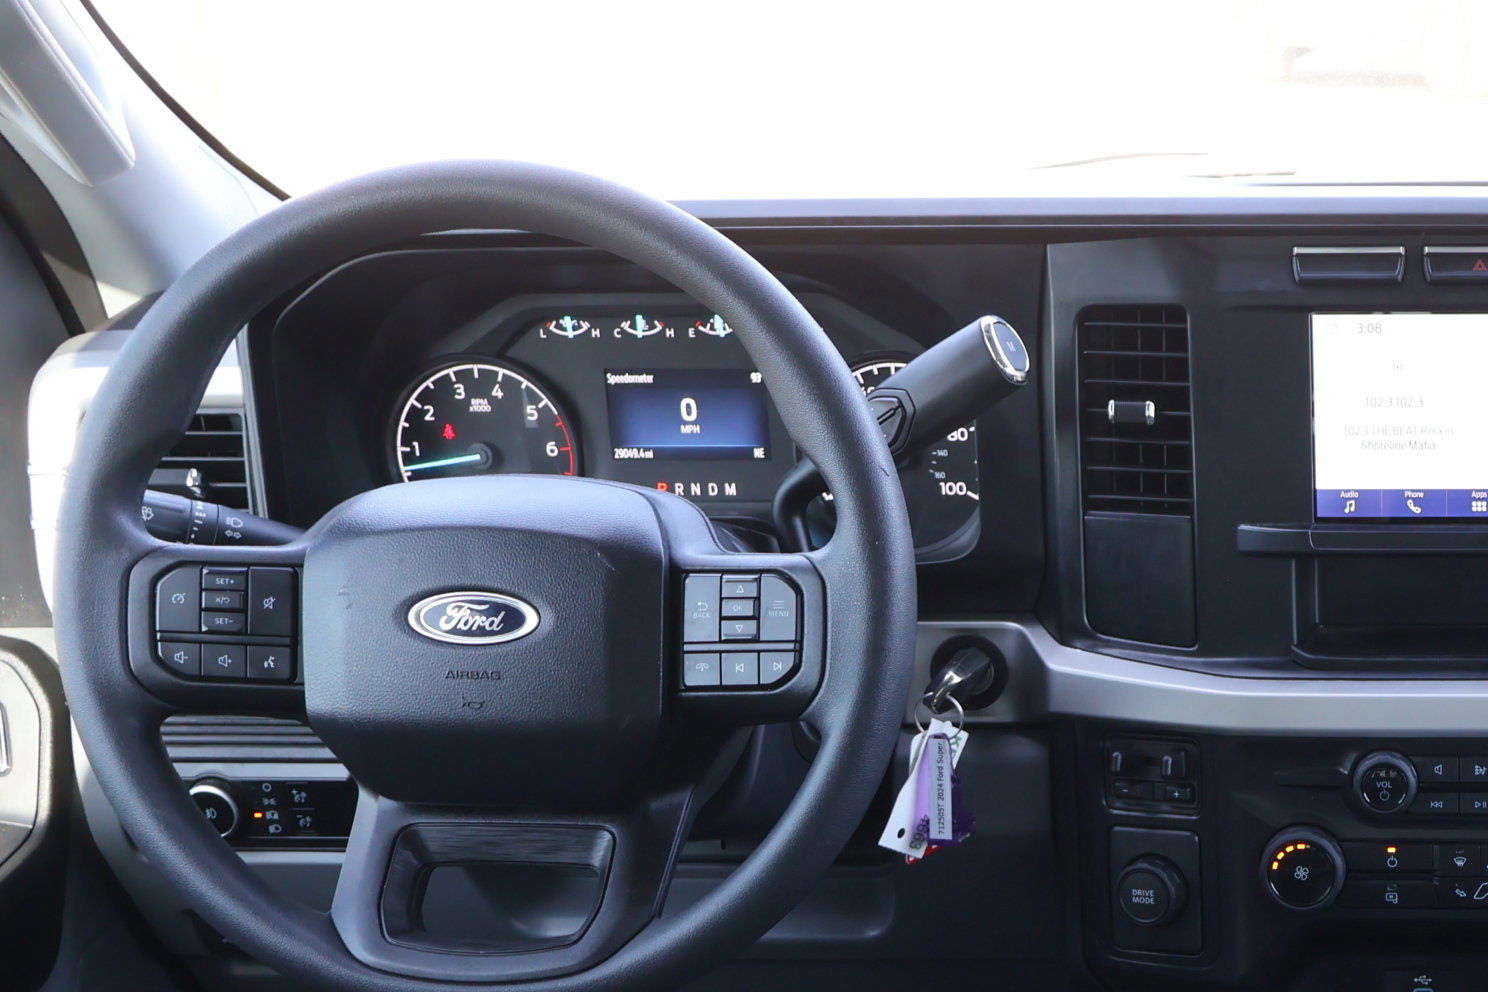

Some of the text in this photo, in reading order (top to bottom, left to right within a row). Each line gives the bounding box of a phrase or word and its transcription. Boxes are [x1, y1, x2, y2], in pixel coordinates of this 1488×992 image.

[540, 329, 547, 338] L
[592, 329, 600, 338] H
[613, 329, 621, 338] C
[666, 329, 674, 338] H
[689, 329, 696, 338] E
[1357, 323, 1382, 334] 3:08
[606, 373, 654, 385] Speedometer
[454, 384, 466, 399] 3
[491, 384, 503, 399] 4
[424, 406, 435, 421] 2
[526, 406, 538, 421] 5
[680, 398, 698, 421] 0
[680, 425, 700, 433] MPH
[411, 442, 419, 456] 1
[546, 442, 558, 456] 6
[1361, 440, 1407, 451] Shoreline
[753, 448, 765, 458] NE
[675, 483, 684, 496] R
[691, 483, 700, 496] N
[708, 483, 718, 496] D
[725, 483, 736, 496] M
[939, 481, 967, 496] 100
[1340, 490, 1359, 498] Audio
[1404, 490, 1424, 498] Phone
[1471, 490, 1487, 500] Apps
[215, 577, 235, 585] SET+
[439, 602, 506, 631] Ford
[445, 670, 502, 680] AIRBAG
[936, 765, 945, 781] Ford
[1376, 781, 1392, 789] VOL
[936, 783, 945, 801] 2024
[1132, 889, 1154, 897] DRIVE
[1132, 896, 1155, 904] MODE
